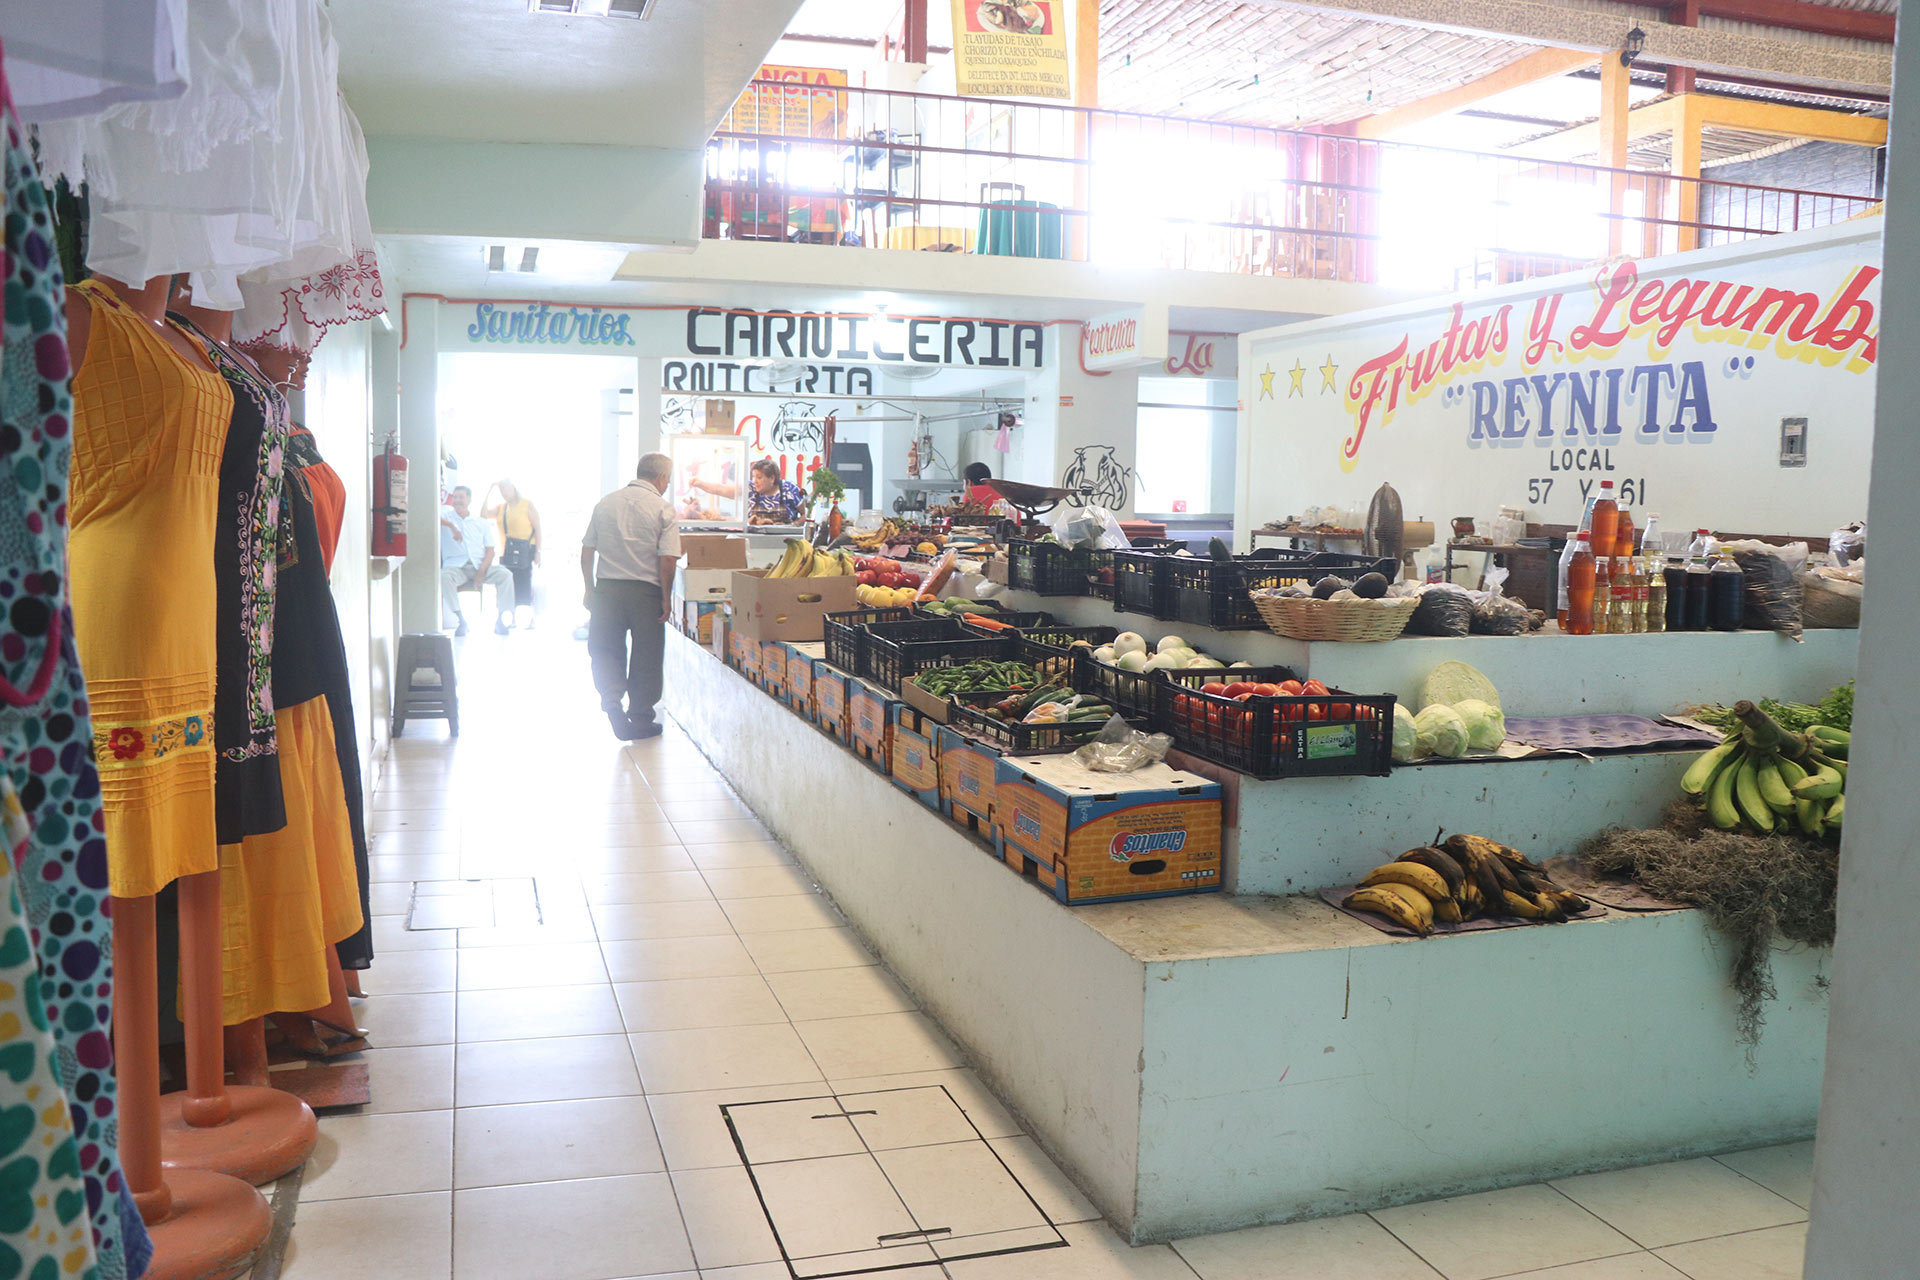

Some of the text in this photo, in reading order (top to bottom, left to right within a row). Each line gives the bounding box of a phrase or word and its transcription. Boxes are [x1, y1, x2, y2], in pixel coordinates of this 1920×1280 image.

[998, 46, 1004, 55] Y
[1005, 36, 1016, 46] DE
[468, 302, 635, 346] Sanitarios
[687, 308, 1044, 368] CARNICERIA
[1343, 301, 1514, 460] Frutas
[1550, 448, 1615, 472] LOCAL
[1528, 477, 1645, 506] 57 Y 61
[1122, 830, 1187, 854] Chanitos
